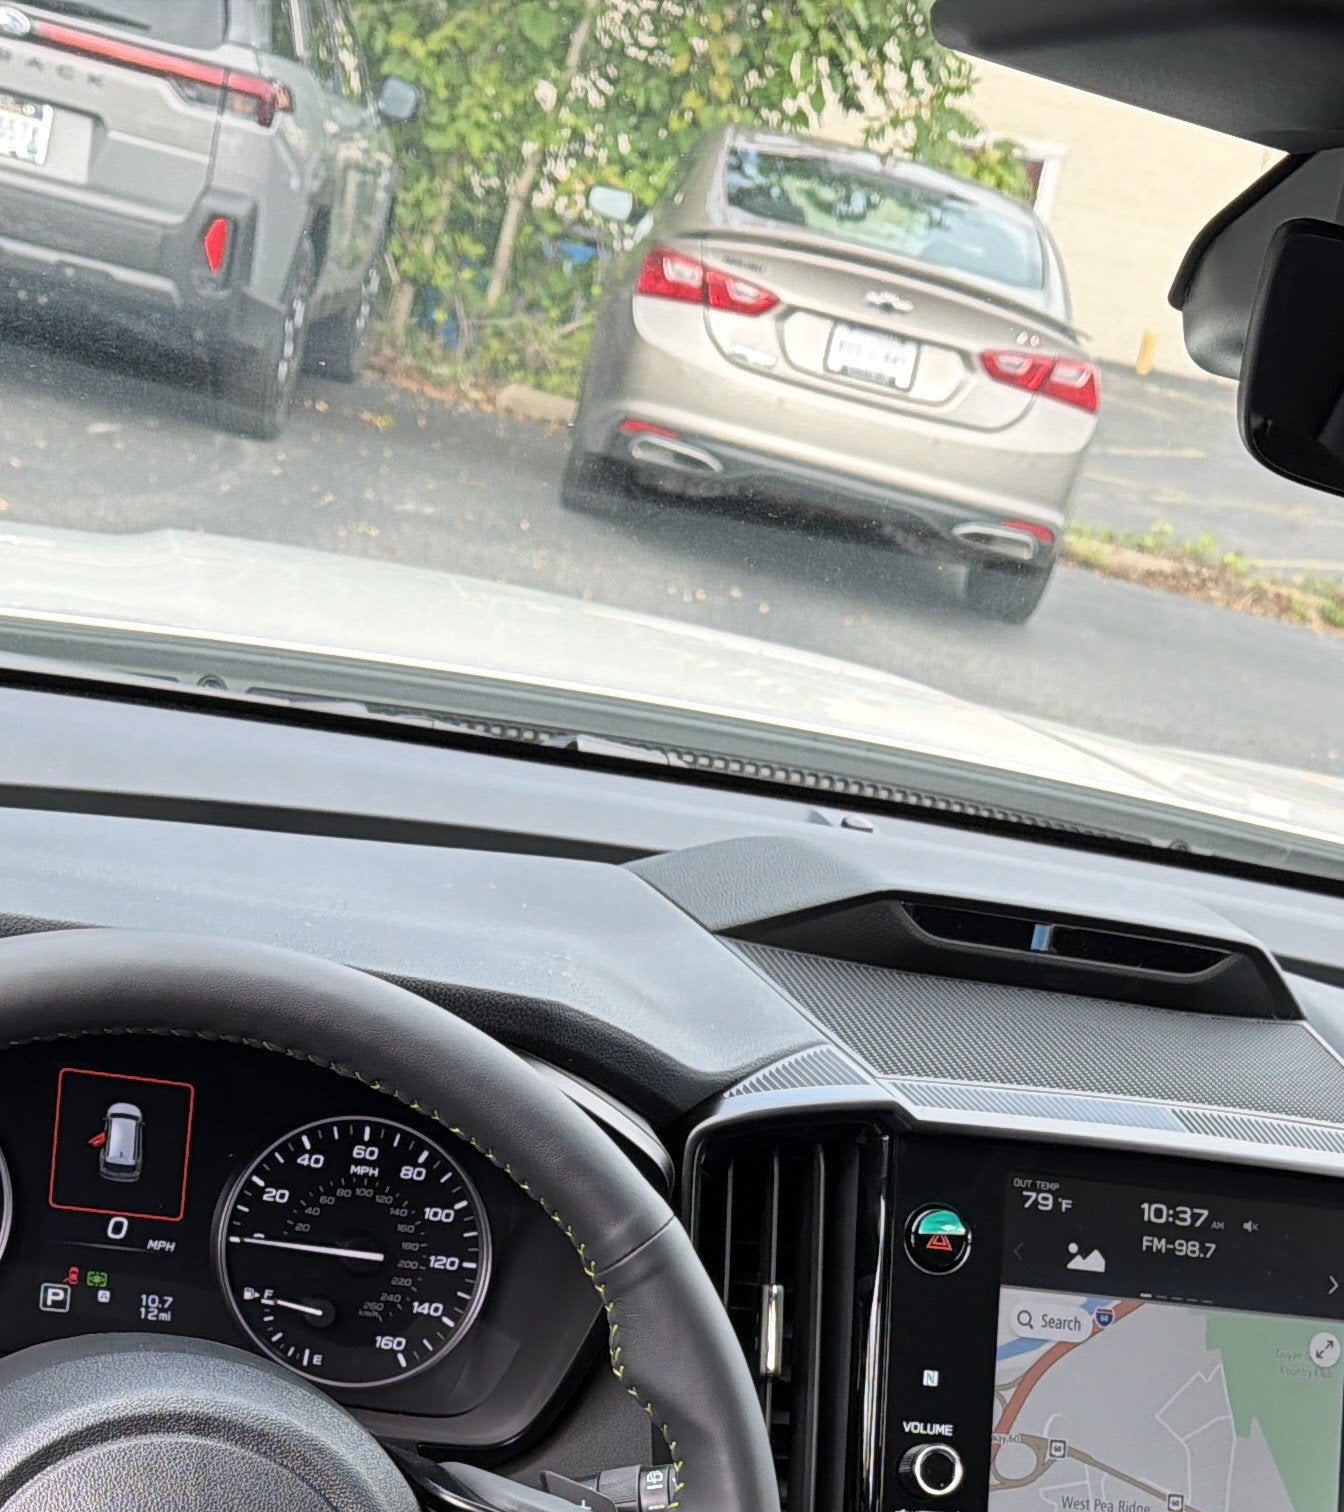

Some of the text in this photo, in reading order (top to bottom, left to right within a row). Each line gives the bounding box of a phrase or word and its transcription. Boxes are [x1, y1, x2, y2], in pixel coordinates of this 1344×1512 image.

[352, 1145, 378, 1160] 60
[296, 1154, 324, 1168] 40
[349, 1164, 379, 1177] MPH
[400, 1165, 426, 1181] 80
[1013, 1178, 1060, 1191] OUT TEMP
[262, 1189, 289, 1203] 20
[319, 1195, 335, 1205] 60
[336, 1187, 352, 1198] 80
[355, 1187, 374, 1198] 100
[375, 1195, 393, 1205] 120
[1022, 1191, 1053, 1212] 79
[305, 1207, 320, 1216] 40
[424, 1207, 454, 1222] 100
[1141, 1203, 1225, 1230] 10:37 AM
[107, 1216, 129, 1239] 0
[295, 1223, 310, 1233] 20
[147, 1239, 176, 1252] MPH
[1142, 1236, 1216, 1259] FM-98.7
[429, 1255, 459, 1270] 120
[46, 1288, 65, 1306] P
[140, 1294, 173, 1309] 10.7
[412, 1302, 443, 1317] 140
[1041, 1313, 1081, 1332] Search
[375, 1335, 406, 1350] 160
[312, 1354, 322, 1365] E
[903, 1421, 953, 1436] VOLUME
[1061, 1496, 1090, 1511] West
[1094, 1500, 1114, 1512] Pea
